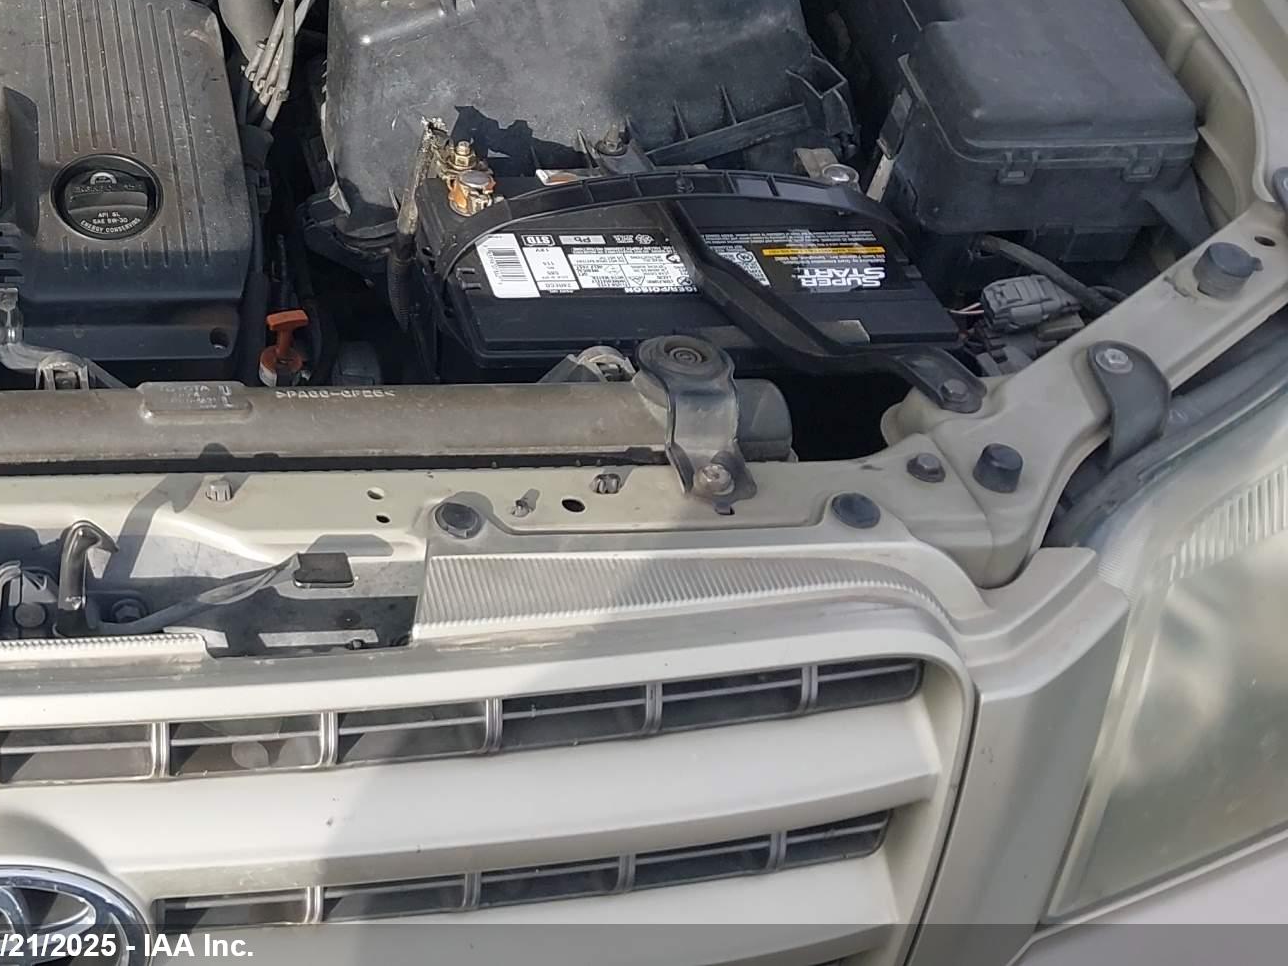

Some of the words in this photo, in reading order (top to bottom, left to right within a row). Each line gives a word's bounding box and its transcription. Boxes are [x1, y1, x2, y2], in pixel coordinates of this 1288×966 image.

[80, 220, 104, 233] ENERGY
[797, 267, 886, 278] START
[801, 277, 881, 287] SUPER
